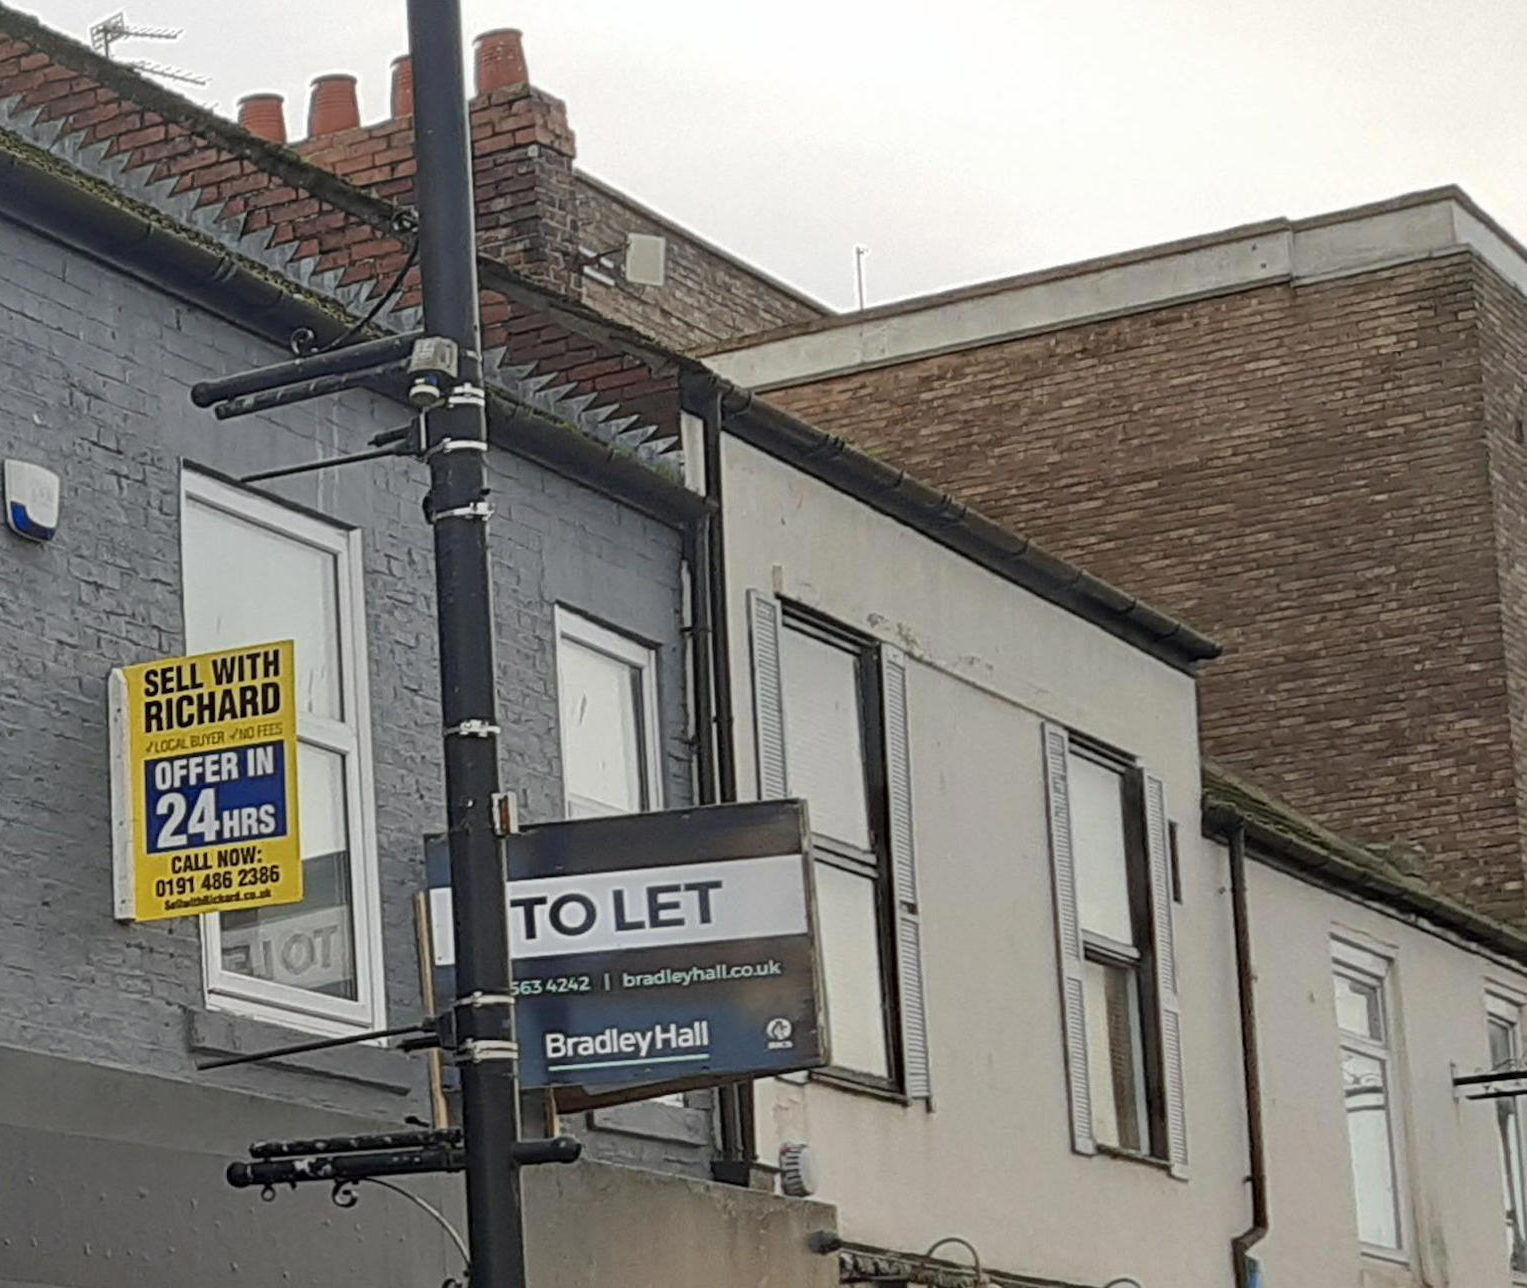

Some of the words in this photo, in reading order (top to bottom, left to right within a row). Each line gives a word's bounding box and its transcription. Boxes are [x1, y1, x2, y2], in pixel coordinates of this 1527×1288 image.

[144, 663, 204, 697] SELL
[212, 649, 280, 686] WITH
[144, 682, 280, 733] RICHARD
[155, 739, 188, 754] LOCAL
[190, 731, 225, 748] BUYER
[239, 727, 255, 740] NO
[257, 722, 283, 737] FEES
[155, 751, 239, 790] OFFER
[248, 746, 274, 777] IN
[156, 788, 220, 849] 24
[222, 804, 276, 839] HRS
[171, 852, 213, 874] CALL
[217, 846, 262, 868] NOW:
[156, 876, 195, 897] 0191
[201, 871, 233, 891] 486
[238, 865, 280, 887] 2386
[510, 893, 596, 940] TO
[612, 880, 722, 932] LET
[510, 980, 542, 996] 563
[546, 976, 591, 993] 4242
[623, 960, 781, 988] bradleyhall.co.uk
[546, 1028, 652, 1059] Bradley
[655, 1020, 709, 1049] Hall
